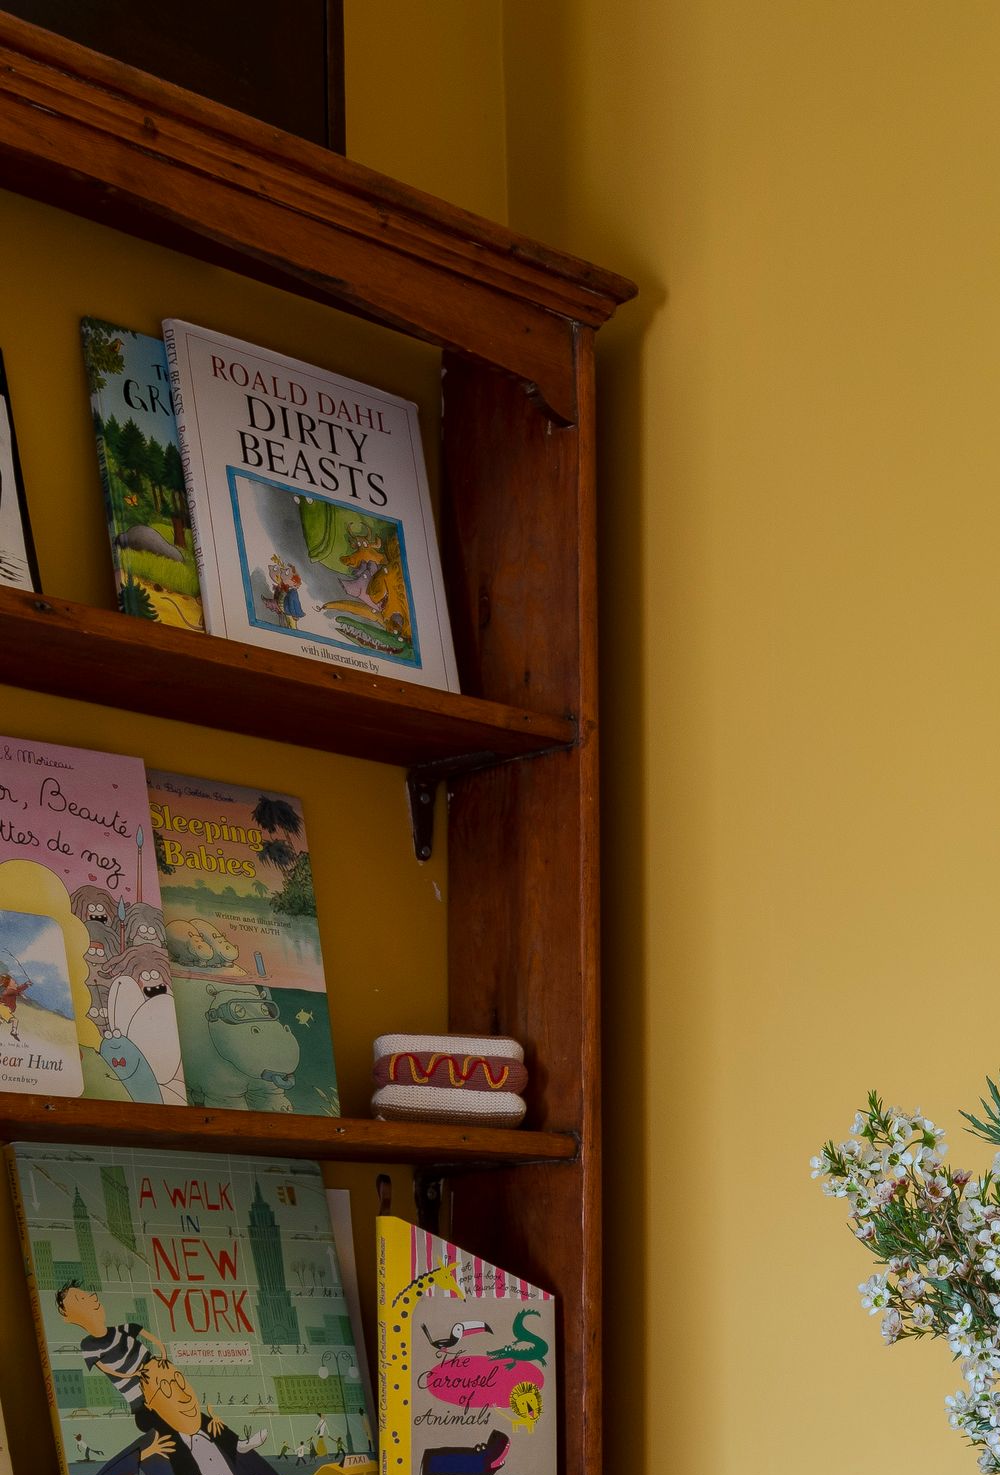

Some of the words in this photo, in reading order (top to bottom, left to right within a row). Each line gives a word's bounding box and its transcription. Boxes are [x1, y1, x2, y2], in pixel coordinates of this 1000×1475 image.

[163, 329, 177, 365] DIRTY
[169, 370, 184, 416] BEASTS
[211, 355, 308, 406] ROALD
[317, 392, 392, 435] DAHL
[244, 394, 369, 464] DIRTY
[237, 430, 388, 507] BEASTS
[184, 487, 194, 496] &
[301, 645, 320, 657] with
[320, 648, 369, 670] illustrations
[369, 660, 380, 673] by
[17, 750, 74, 769] Moriceau
[164, 783, 183, 798] Big
[183, 786, 212, 800] Golden
[40, 777, 132, 839] Beauté
[149, 802, 265, 852] Sleeping
[47, 831, 74, 855] de
[81, 850, 125, 889] nez
[162, 839, 257, 879] Babies
[215, 912, 241, 922] Written
[243, 916, 256, 925] and
[257, 917, 292, 929] illustrated
[230, 923, 238, 931] by
[239, 924, 259, 934] TONY
[260, 927, 280, 936] AUTH
[27, 1053, 64, 1072] Hunt
[1, 1073, 39, 1086] Oxenbury
[139, 1177, 157, 1209] A
[163, 1179, 234, 1211] WALK
[180, 1215, 201, 1233] IN
[152, 1237, 238, 1281] NEW
[153, 1288, 255, 1332] YORK
[378, 1320, 386, 1358] Animals
[177, 1349, 214, 1358] SALVATORE
[379, 1360, 391, 1368] of
[435, 1349, 471, 1368] The
[37, 1341, 48, 1368] NEW
[43, 1374, 56, 1407] YORK
[417, 1365, 500, 1390] Carousel
[378, 1372, 387, 1410] Carousel
[458, 1390, 476, 1416] of
[413, 1402, 492, 1426] Animals
[346, 1456, 366, 1465] TAXI
